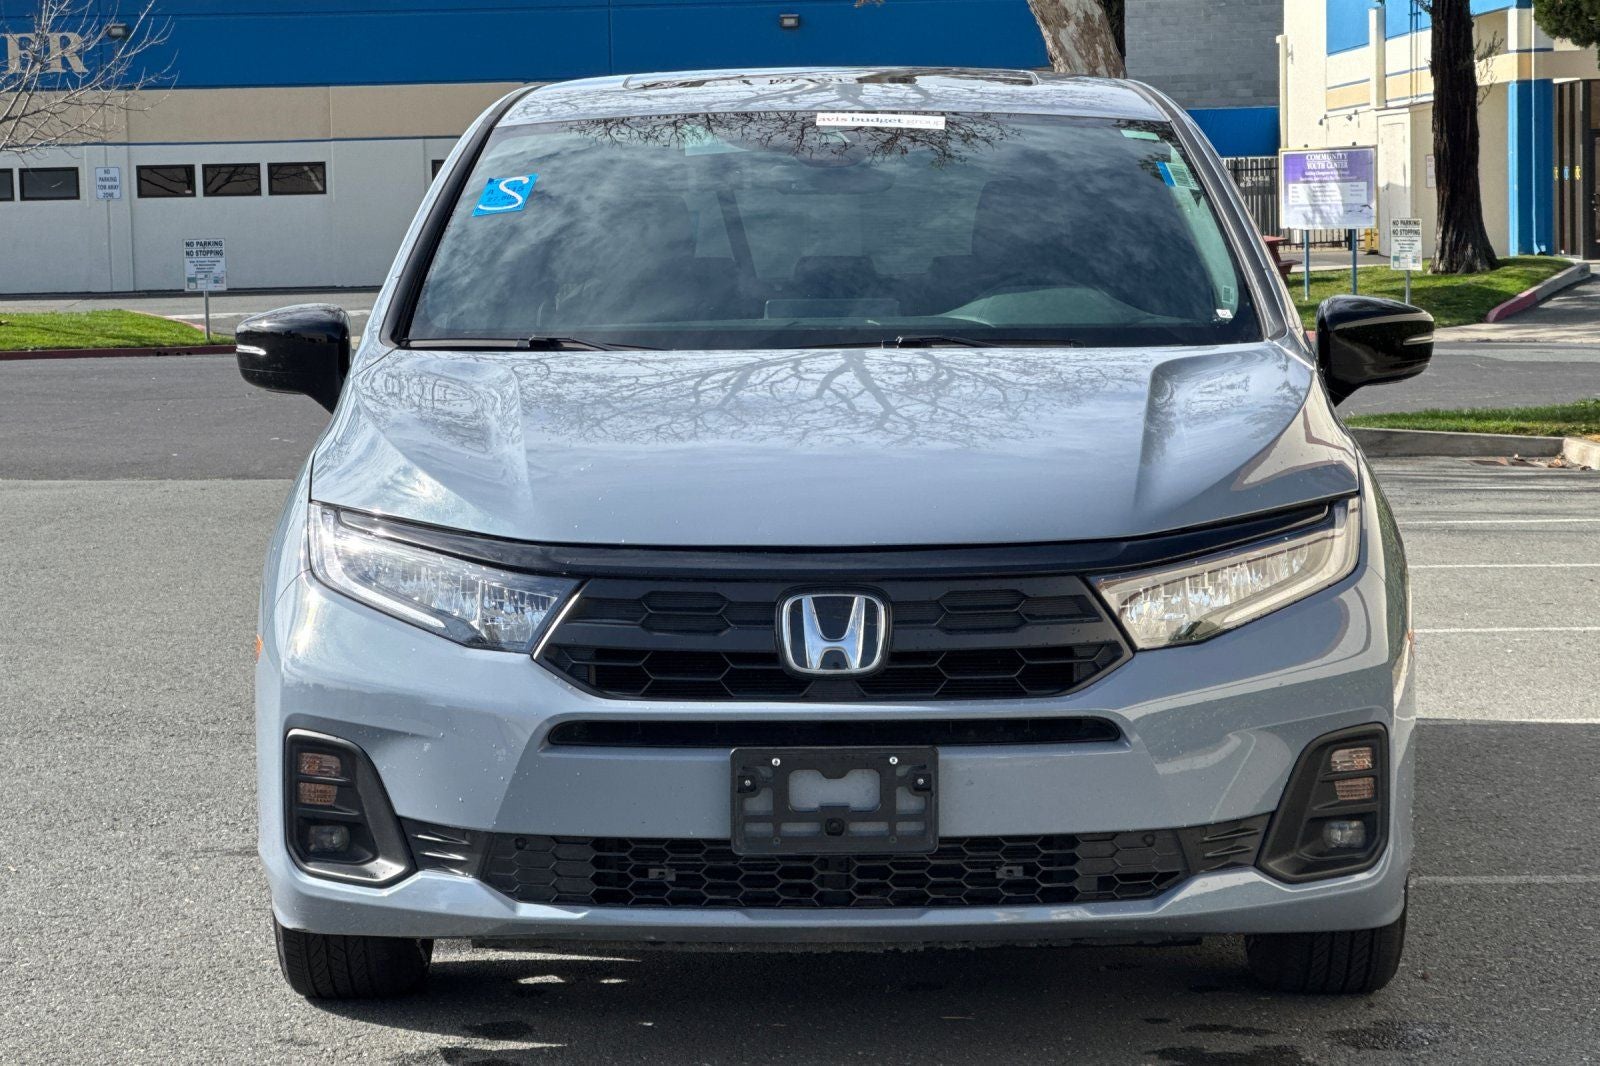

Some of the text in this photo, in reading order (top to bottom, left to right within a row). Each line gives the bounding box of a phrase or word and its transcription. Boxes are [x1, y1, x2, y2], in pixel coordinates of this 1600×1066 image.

[818, 115, 849, 123] avis
[850, 116, 904, 126] budget
[1305, 161, 1349, 170] YOUTH CENTER
[478, 176, 529, 210] S
[1392, 228, 1421, 236] NO STOPPING
